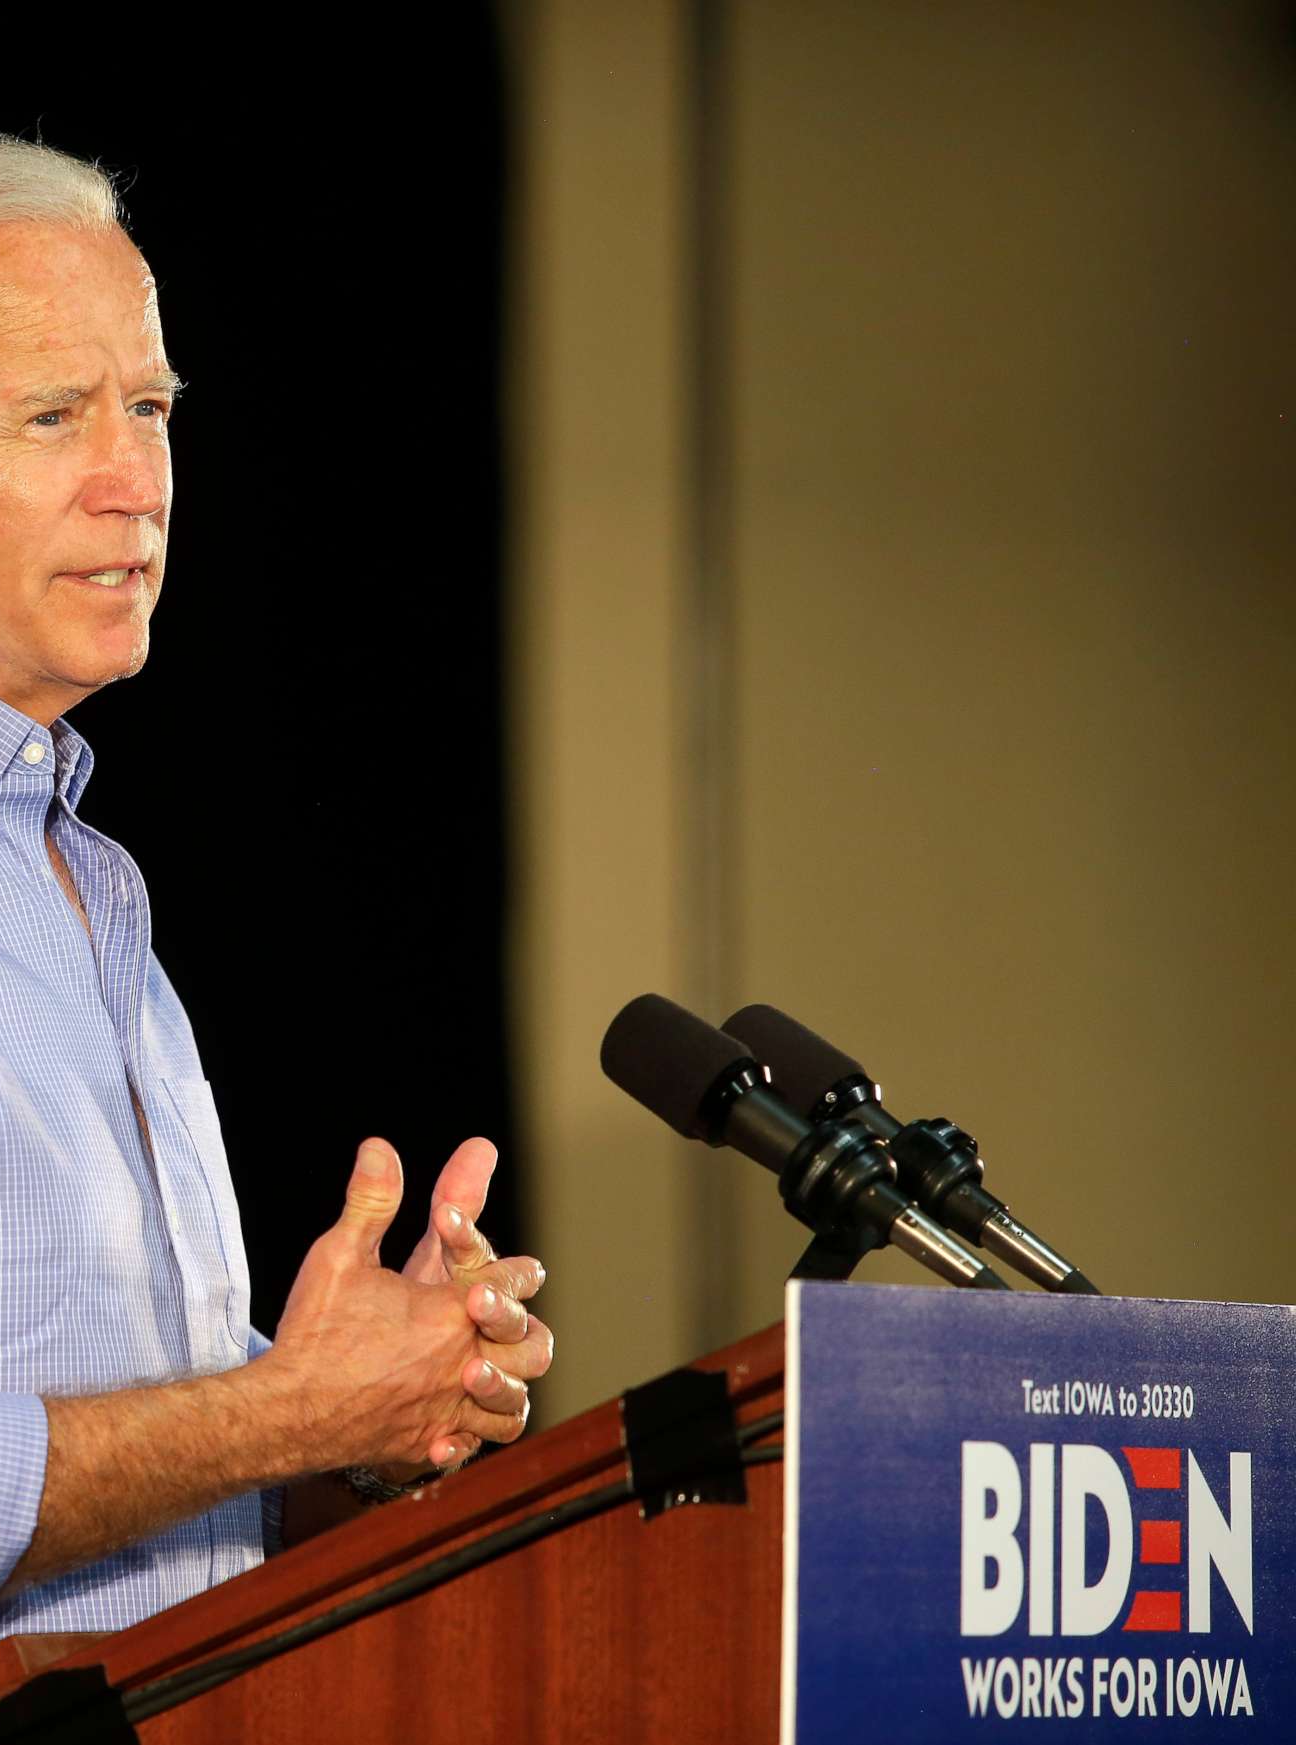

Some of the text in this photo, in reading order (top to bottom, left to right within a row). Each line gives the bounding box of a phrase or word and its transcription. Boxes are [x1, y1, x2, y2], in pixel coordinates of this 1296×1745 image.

[1021, 1379, 1194, 1419] Text IOWA to 30330
[960, 1440, 1254, 1637] BIDEN
[960, 1656, 1255, 1719] WORKS FOR IOWA
